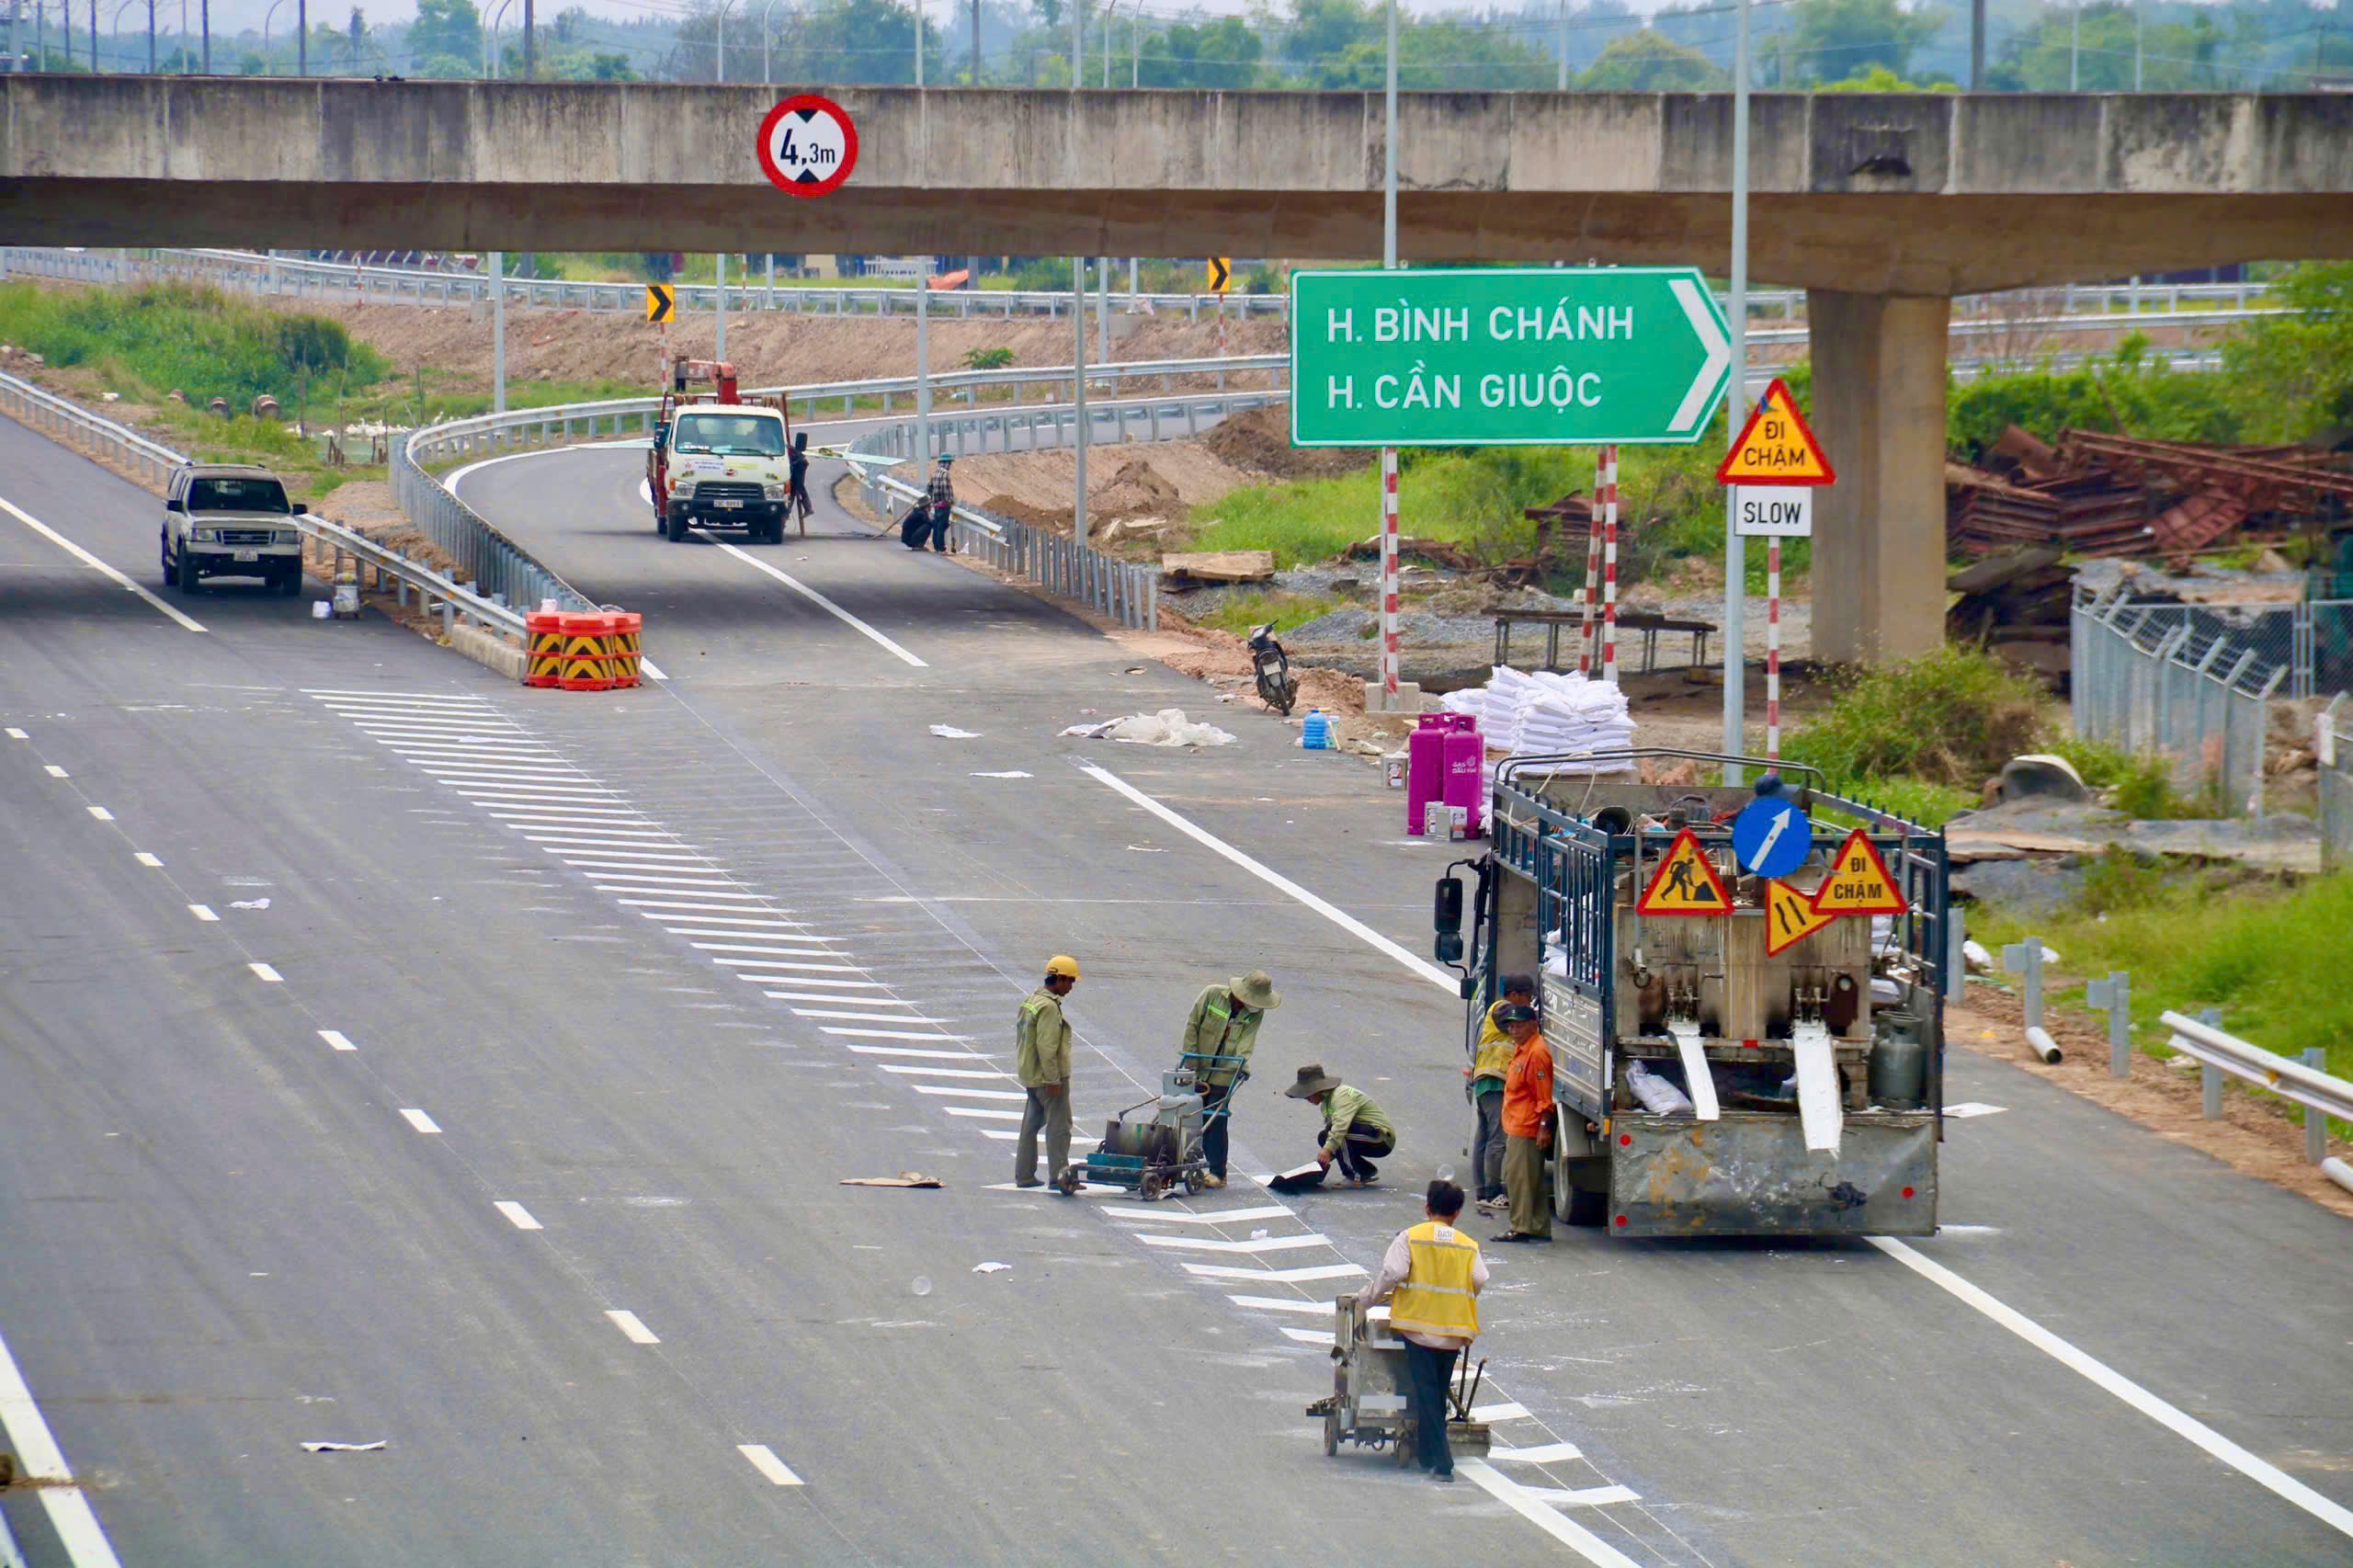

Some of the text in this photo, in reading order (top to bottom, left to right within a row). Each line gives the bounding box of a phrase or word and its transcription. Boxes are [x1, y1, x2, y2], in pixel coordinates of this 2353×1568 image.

[779, 128, 835, 166] 4,3m
[1327, 296, 1633, 342] H. BÌNH CHÁNH
[1328, 359, 1602, 414] H. CẦN GIUỘC
[1764, 421, 1785, 440] ĐI
[1744, 444, 1805, 472] CHẬM
[1744, 501, 1802, 524] SLOW
[1850, 857, 1867, 873] ĐI
[1834, 880, 1882, 903] CHẬM
